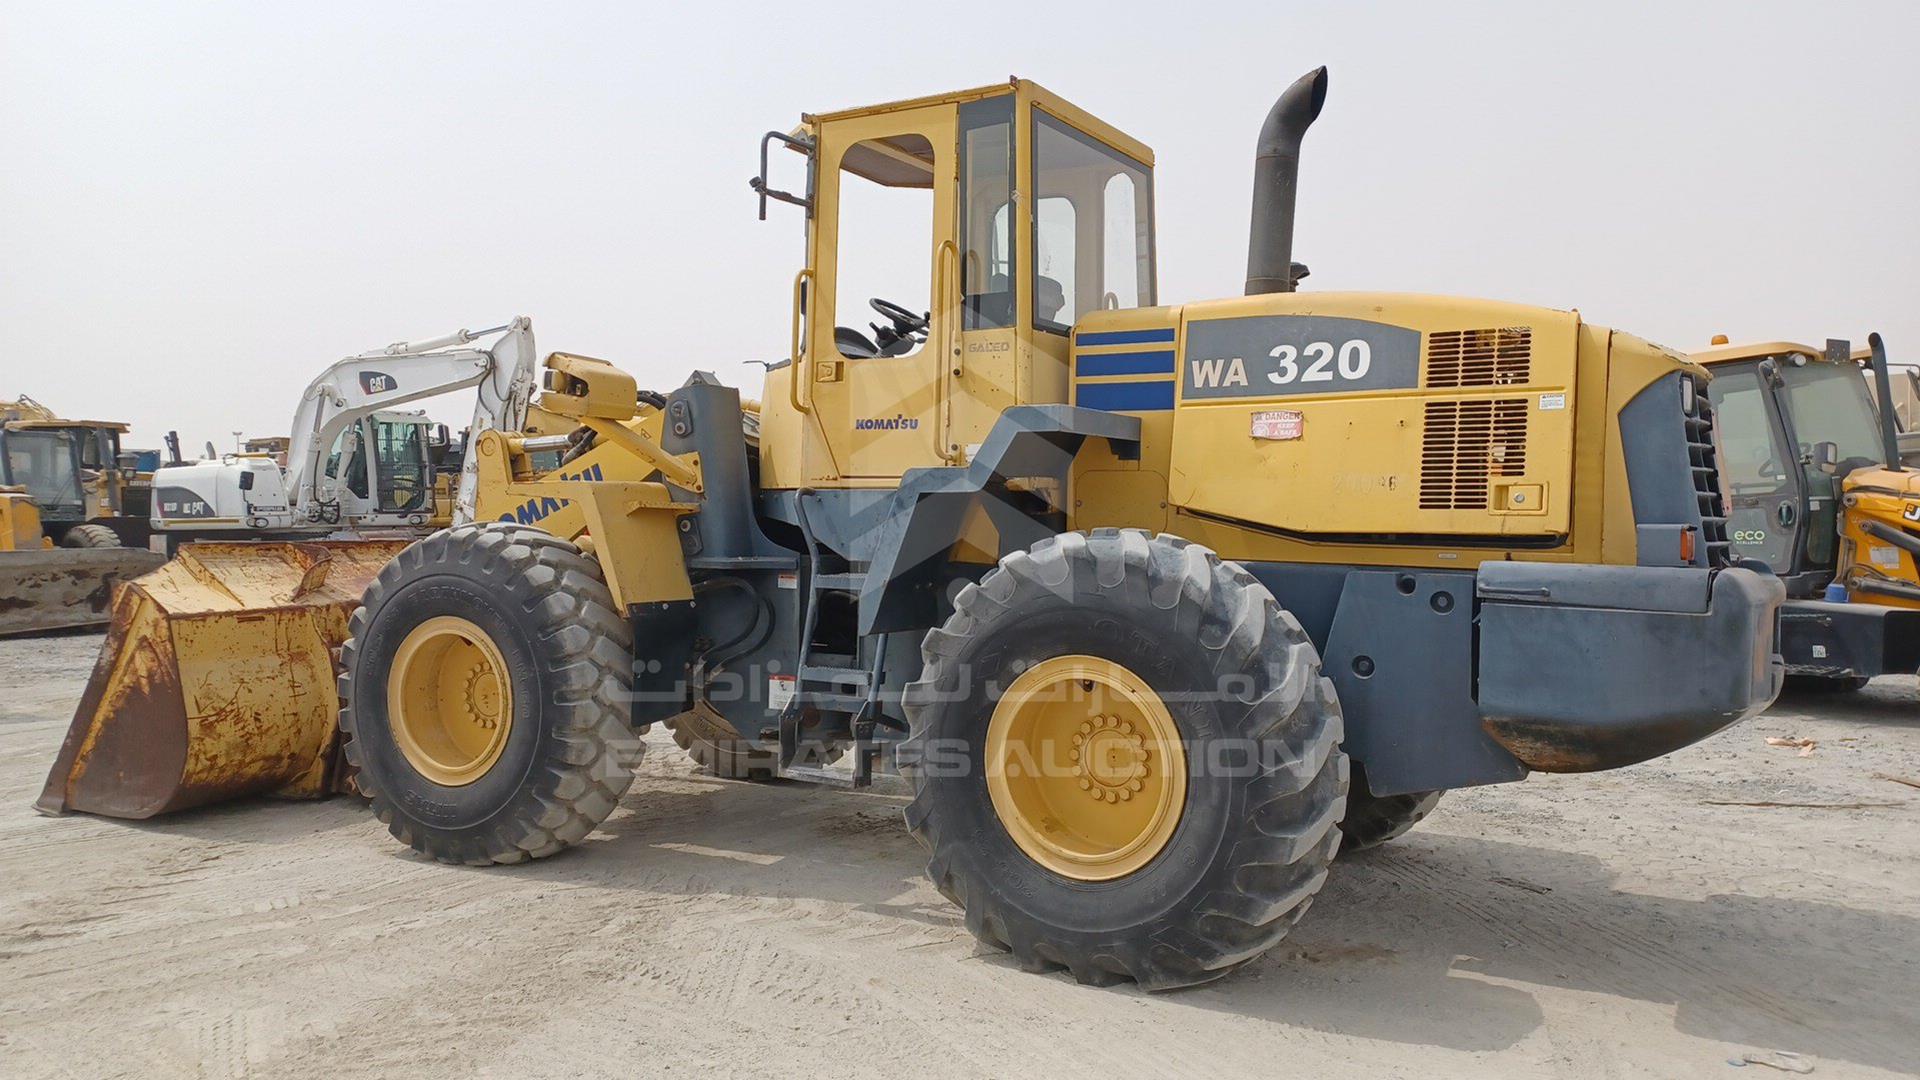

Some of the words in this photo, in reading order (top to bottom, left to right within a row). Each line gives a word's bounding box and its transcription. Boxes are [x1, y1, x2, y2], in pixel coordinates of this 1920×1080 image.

[968, 341, 1010, 353] GALEO
[1191, 357, 1248, 388] WA
[1266, 338, 1373, 386] 320
[369, 375, 387, 392] CAT
[855, 413, 919, 430] KOMATSU
[1265, 411, 1301, 421] DANGER
[1734, 530, 1766, 541] eco
